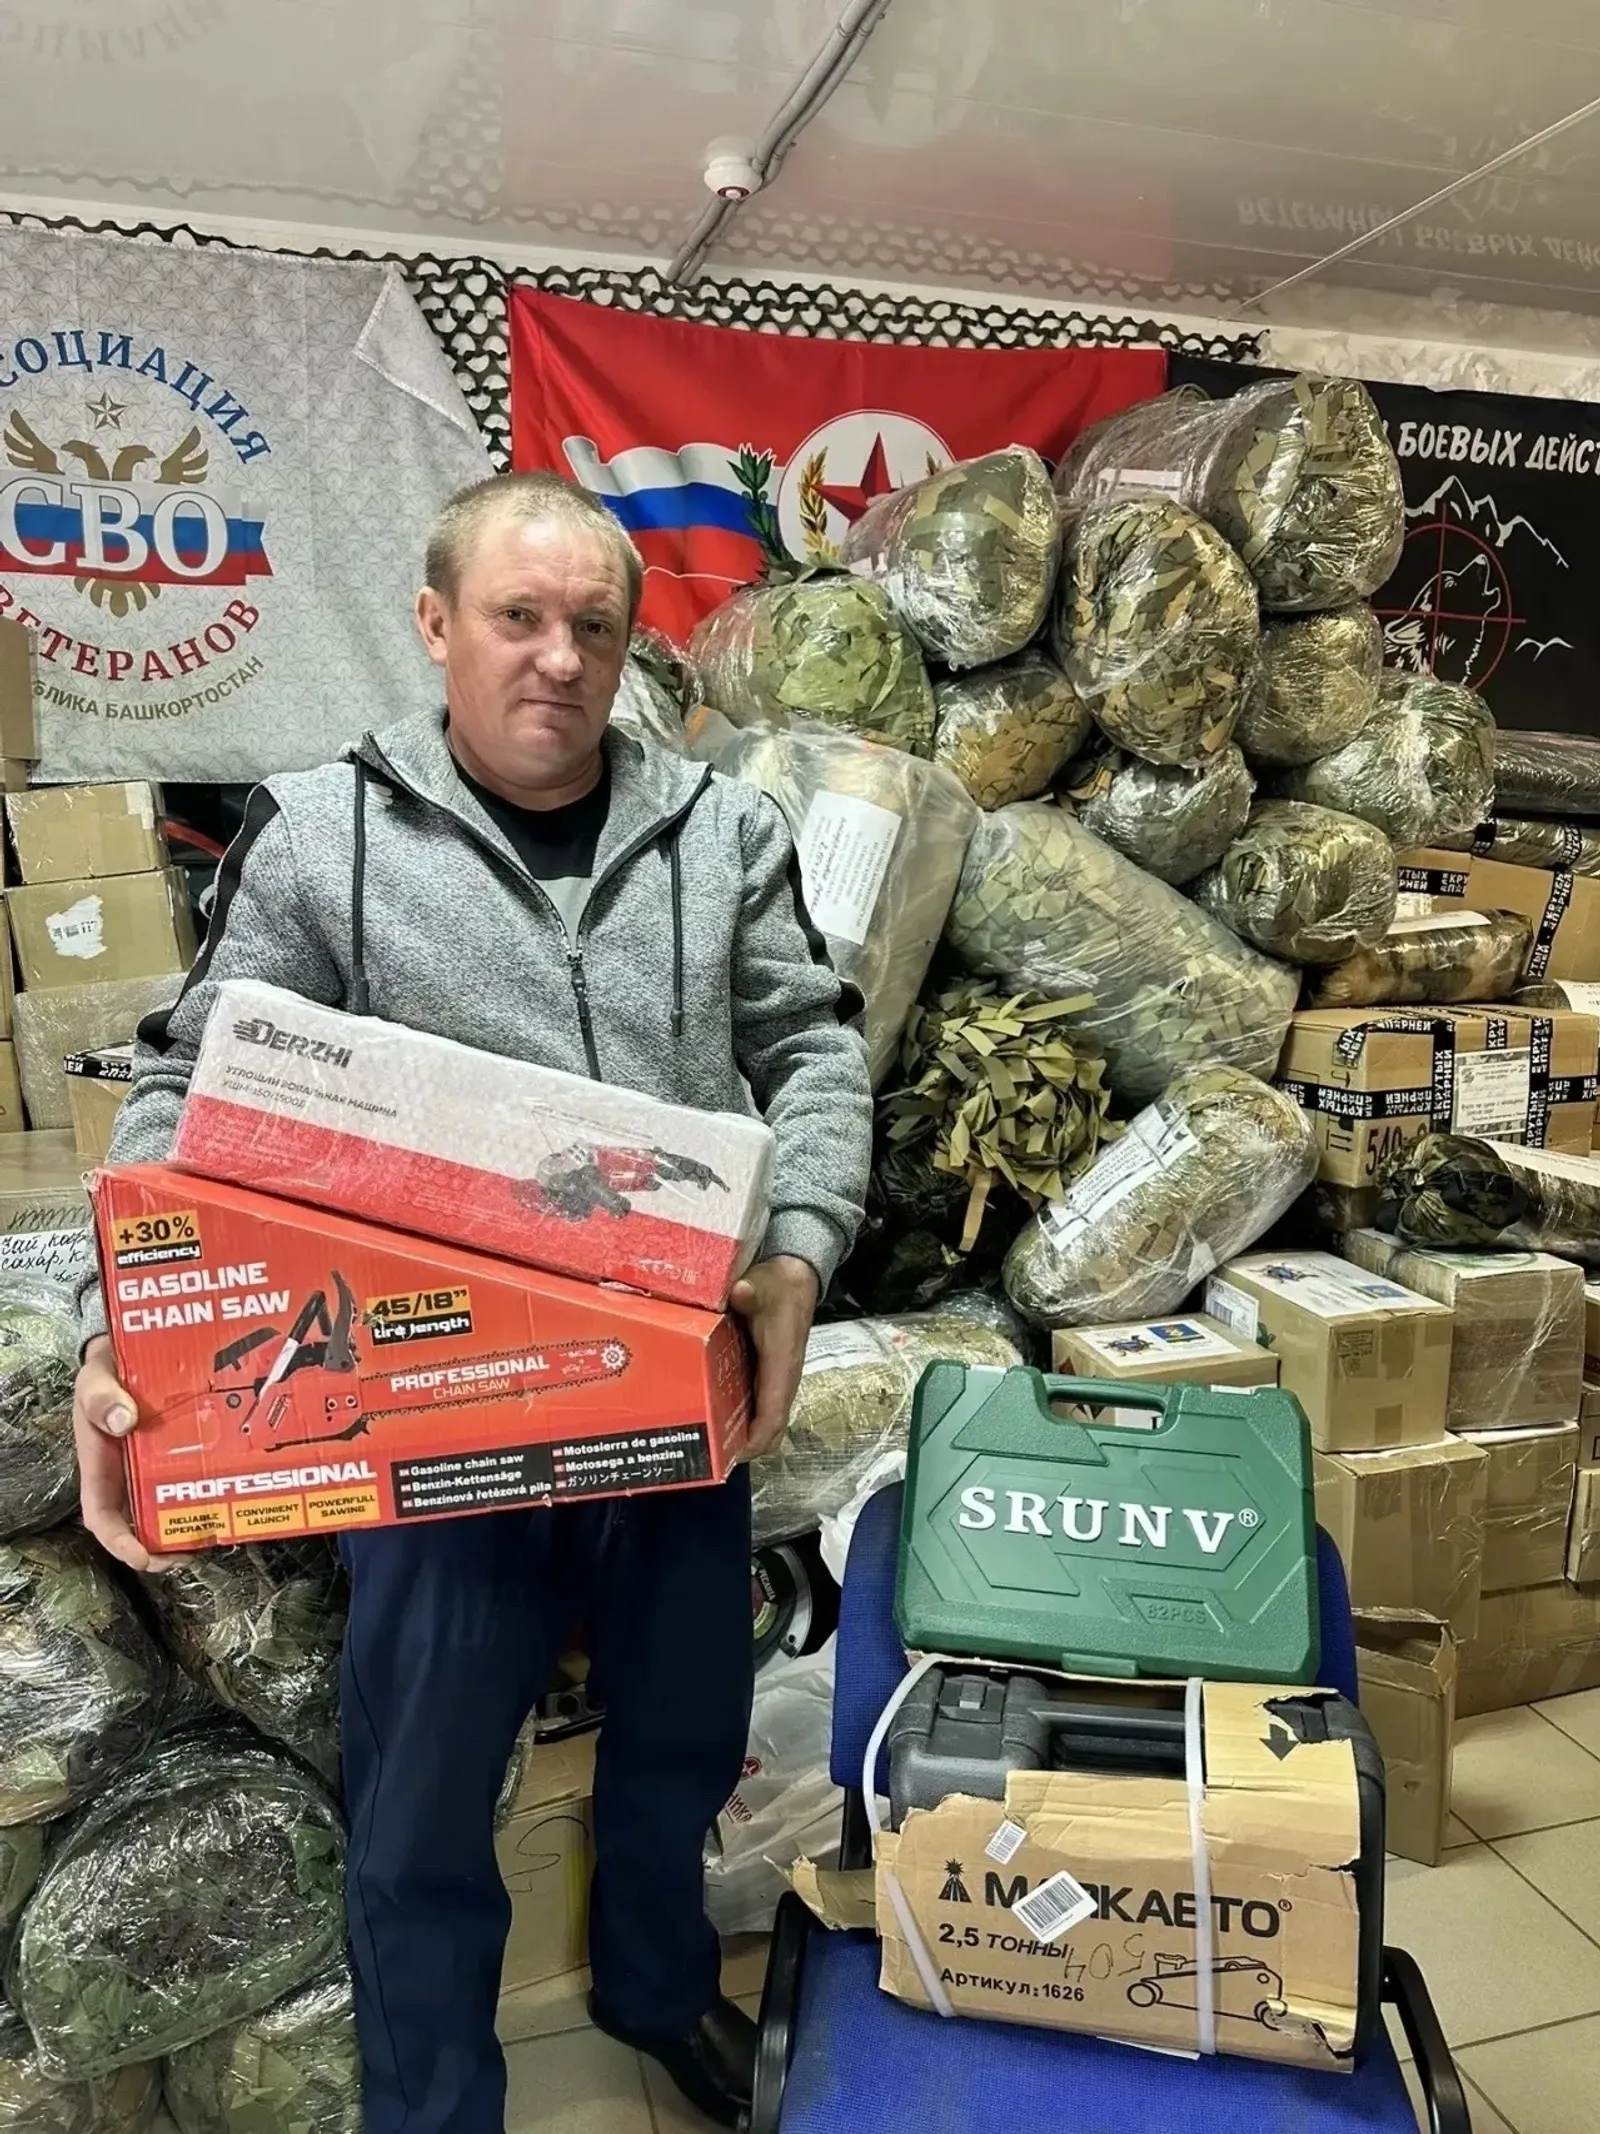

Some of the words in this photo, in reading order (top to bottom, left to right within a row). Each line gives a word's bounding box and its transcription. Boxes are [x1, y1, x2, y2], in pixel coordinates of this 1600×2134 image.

[1397, 421, 1522, 468] БОЕВЫХ
[0, 477, 228, 577] СВО
[105, 656, 264, 721] БАШКОРТОСТАН
[246, 1018, 353, 1068] DERZHI
[347, 1099, 397, 1118] МАШИНА
[119, 1216, 194, 1244] +30%
[117, 1245, 200, 1265] efficiency
[118, 1261, 268, 1301] GASOLINE
[122, 1300, 214, 1332] CHAIN
[221, 1290, 290, 1320] SAW
[410, 1316, 470, 1336] length
[390, 1354, 550, 1392] PROFESSIONAL
[432, 1384, 476, 1400] CHAIN
[478, 1377, 511, 1394] SAW
[563, 1440, 629, 1456] Motosierra
[631, 1437, 646, 1448] de
[649, 1431, 700, 1448] gasolina
[410, 1462, 462, 1476] Gasoline
[464, 1456, 497, 1469] chain
[500, 1453, 524, 1464] saw
[565, 1457, 625, 1473] Motosega
[627, 1456, 635, 1464] a
[637, 1448, 685, 1464] benzina
[155, 1460, 378, 1504] PROFESSIONAL
[412, 1470, 522, 1492] Benzin-Kettensäge
[567, 1465, 674, 1488] ガソリンチェーンソー
[529, 1482, 551, 1495] pila
[236, 1503, 299, 1518] CONVINIENT
[308, 1495, 376, 1509] POWERFULL
[321, 1505, 366, 1518] SAWING
[164, 1522, 226, 1536] OPERATION
[169, 1512, 220, 1526] RELIABLE
[247, 1514, 290, 1526] LAUNCH
[939, 1923, 980, 1947] 2,5
[940, 1967, 1085, 2001] Артикул:1626
